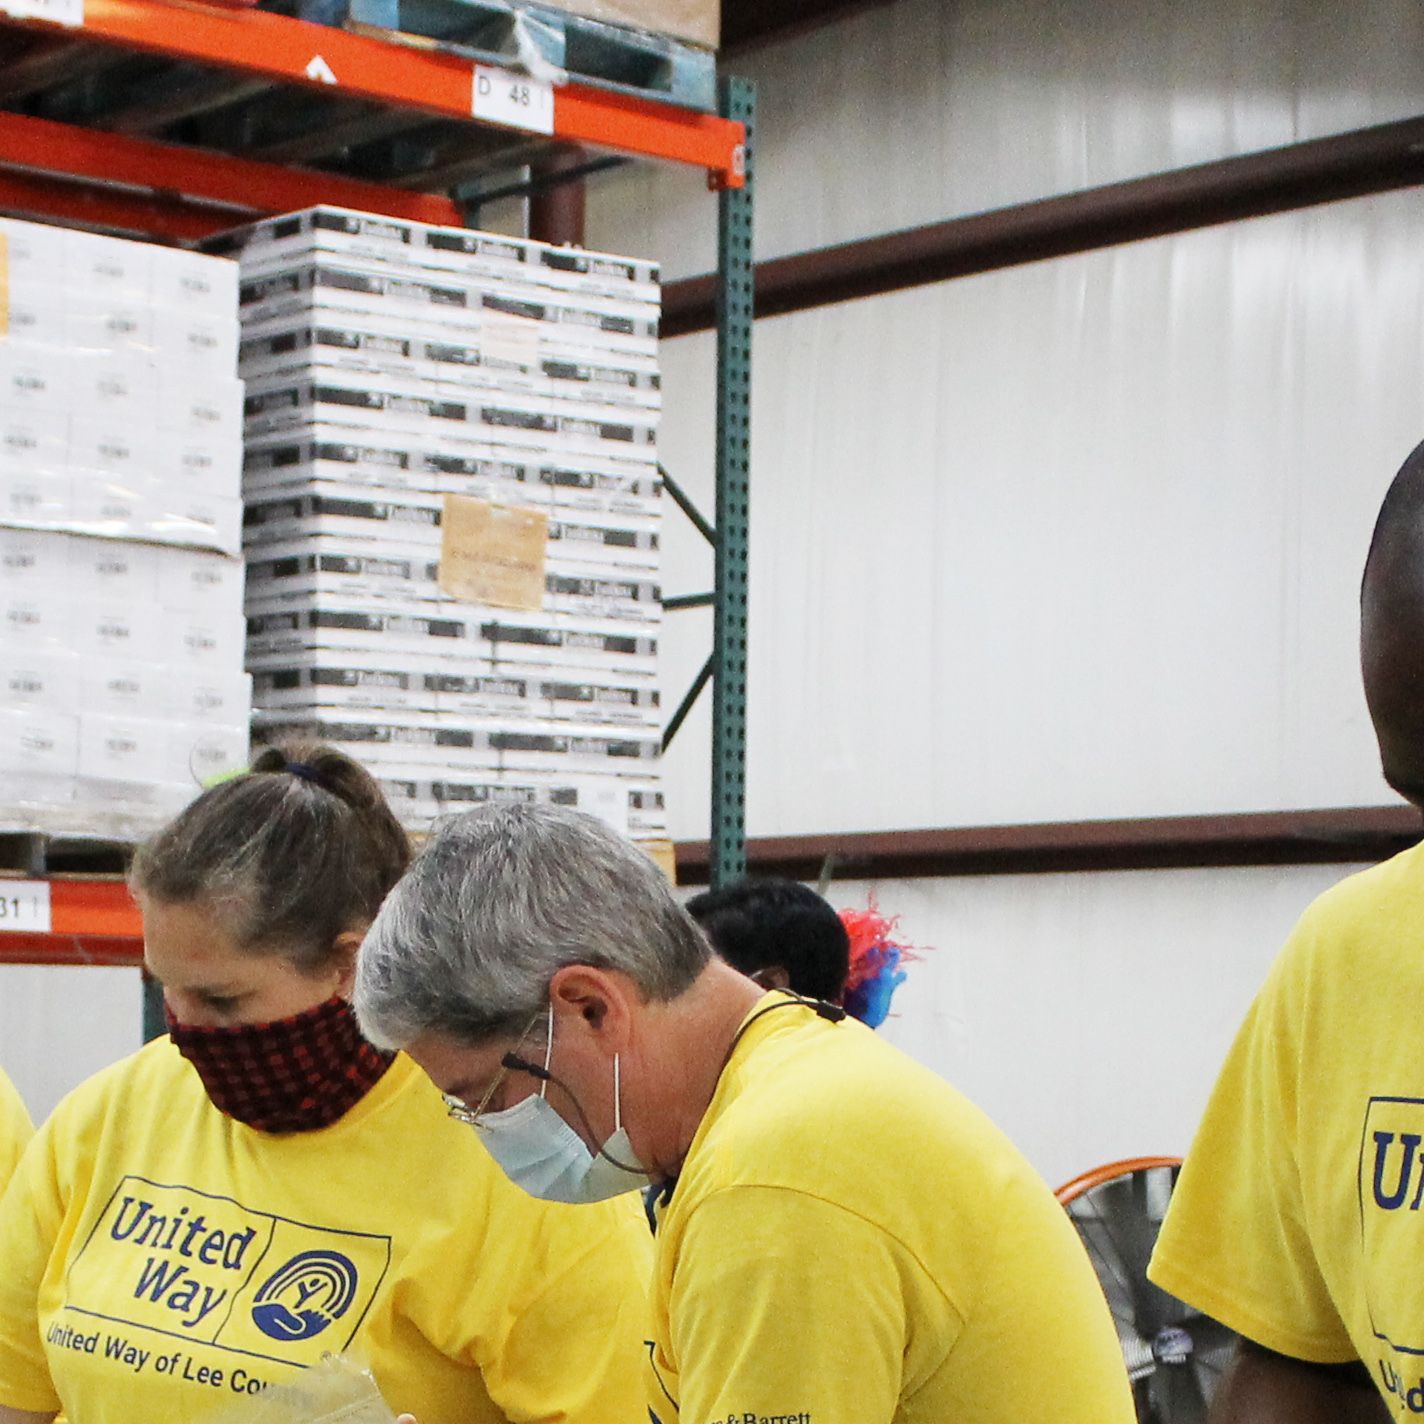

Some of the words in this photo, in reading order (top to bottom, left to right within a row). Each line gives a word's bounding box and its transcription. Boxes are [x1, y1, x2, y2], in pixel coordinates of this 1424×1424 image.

[478, 76, 492, 95] D
[508, 84, 530, 106] 48
[111, 1197, 255, 1270] United
[133, 1257, 227, 1329] Way
[47, 1321, 100, 1354] United
[105, 1336, 150, 1372] Way
[155, 1353, 181, 1375] of
[183, 1357, 223, 1387] Lee
